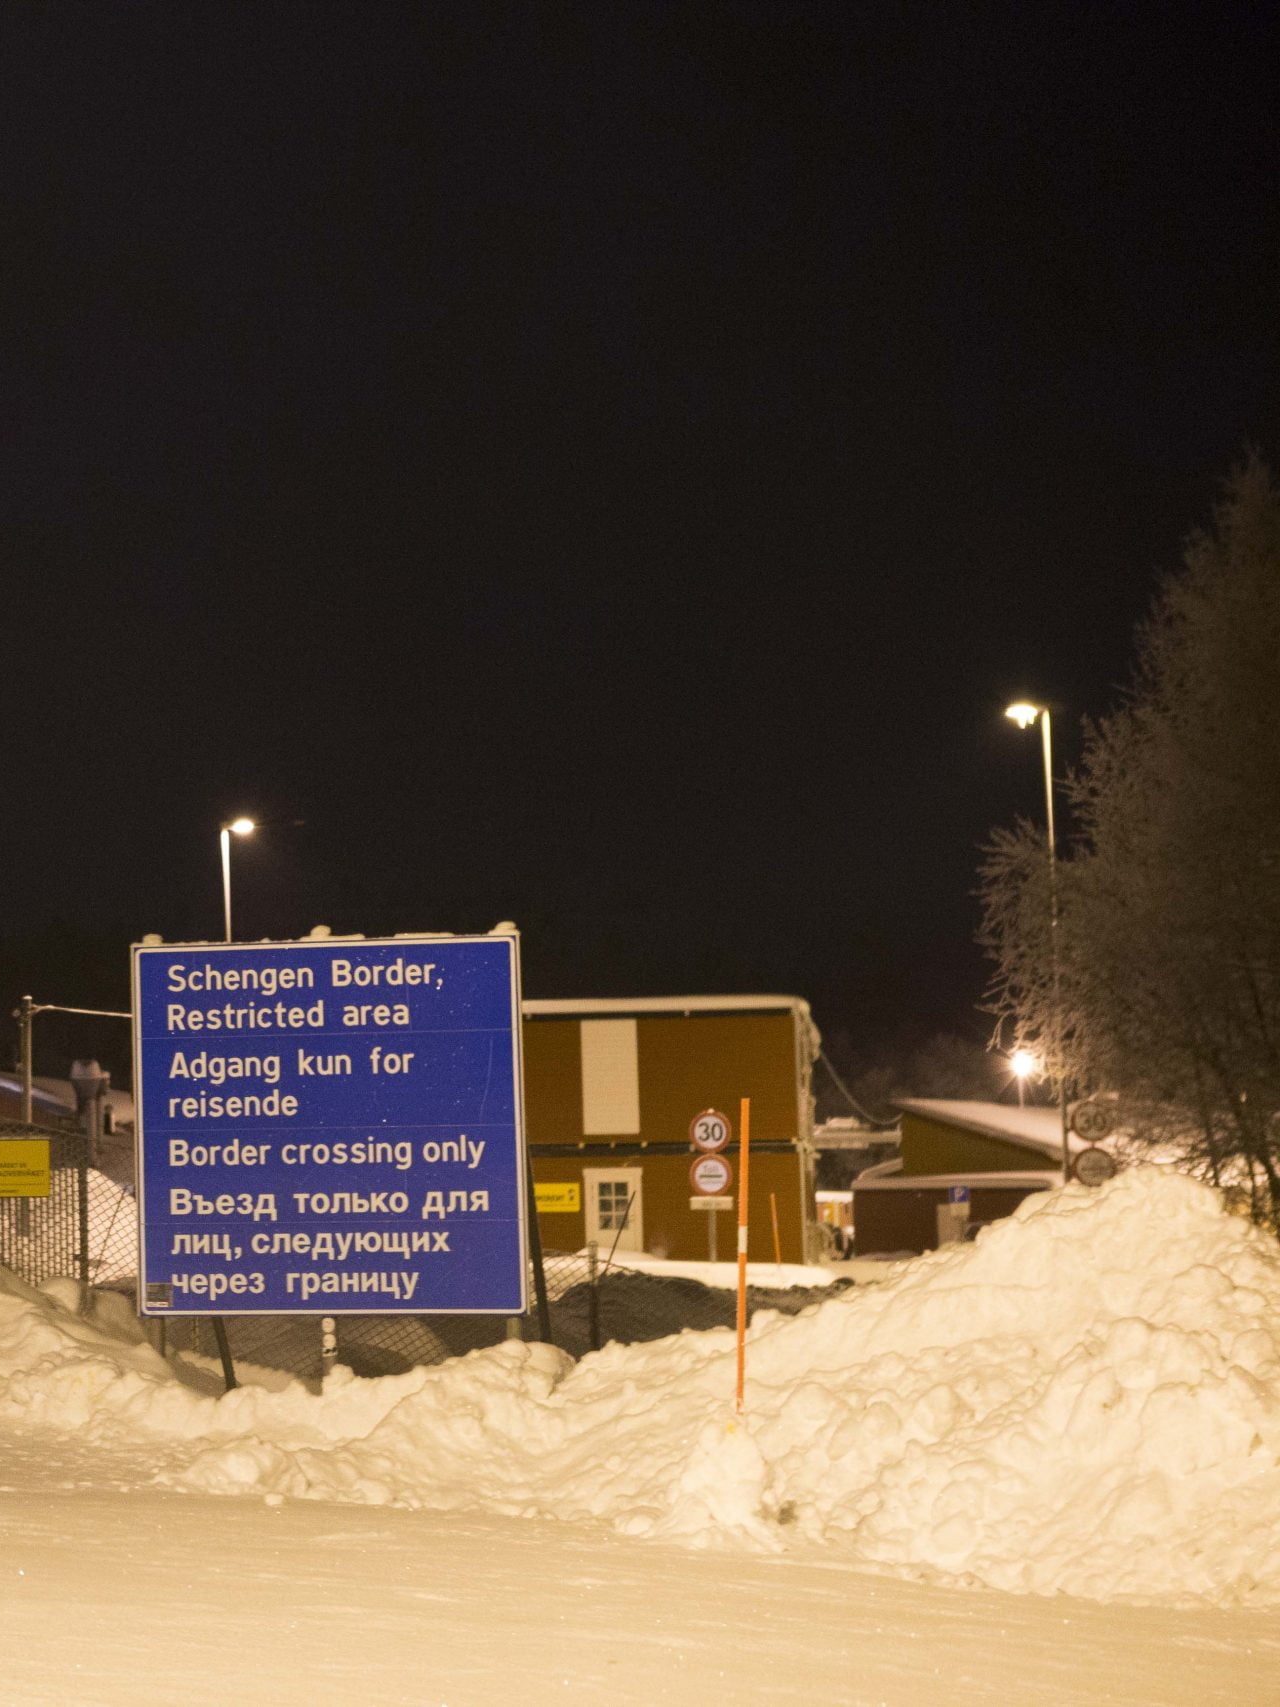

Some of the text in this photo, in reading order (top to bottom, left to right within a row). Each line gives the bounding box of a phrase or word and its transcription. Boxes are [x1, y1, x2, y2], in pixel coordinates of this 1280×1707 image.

[167, 959, 443, 996] Schengen Border,
[167, 1000, 410, 1031] Restricted area
[169, 1047, 415, 1084] Adgang kun for
[169, 1089, 299, 1118] reisende
[698, 1122, 723, 1141] 30
[169, 1135, 486, 1170] Border crossing only
[170, 1188, 490, 1221] Въезд только для
[171, 1231, 451, 1262] лиц, следующих
[171, 1272, 420, 1301] через границу
